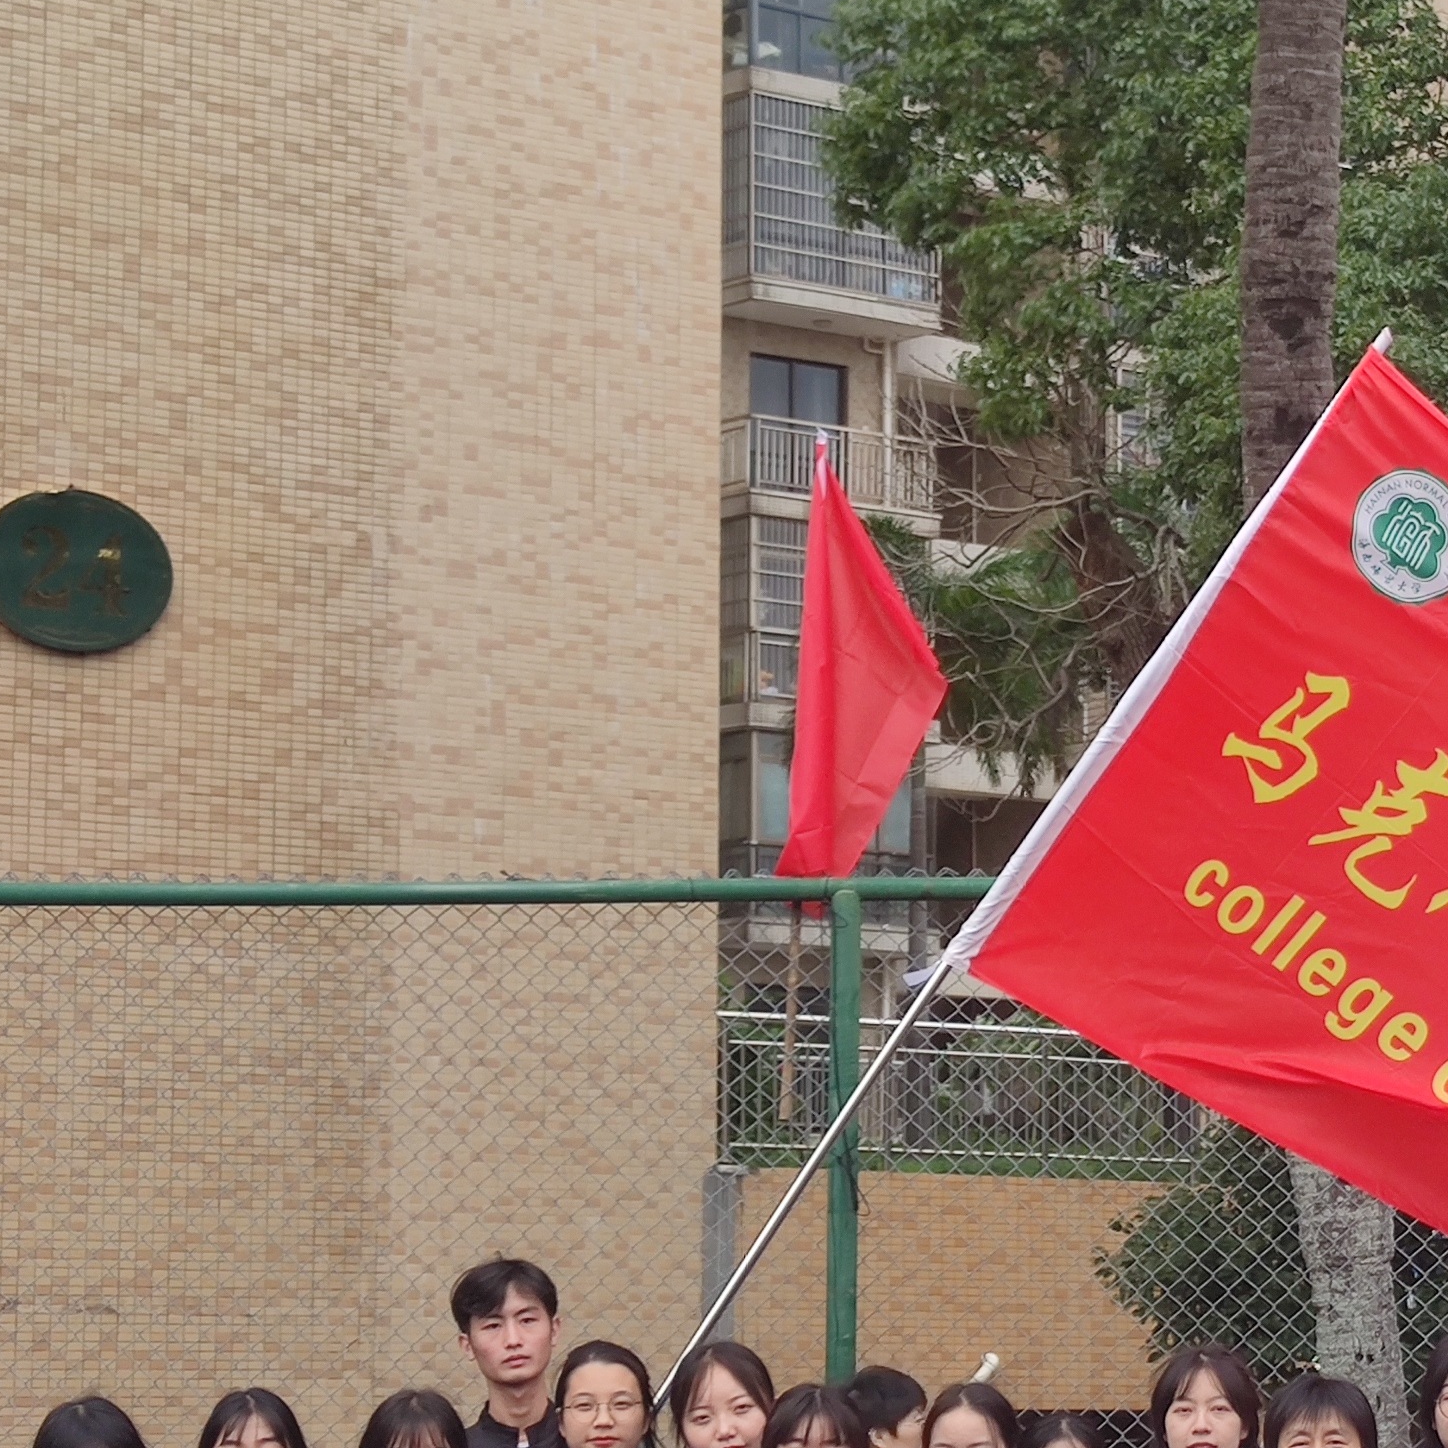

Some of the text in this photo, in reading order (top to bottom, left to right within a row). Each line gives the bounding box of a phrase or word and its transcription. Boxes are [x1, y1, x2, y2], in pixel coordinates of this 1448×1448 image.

[1364, 479, 1402, 515] HAINAN
[20, 524, 129, 618] 24
[1183, 859, 1429, 1061] college
